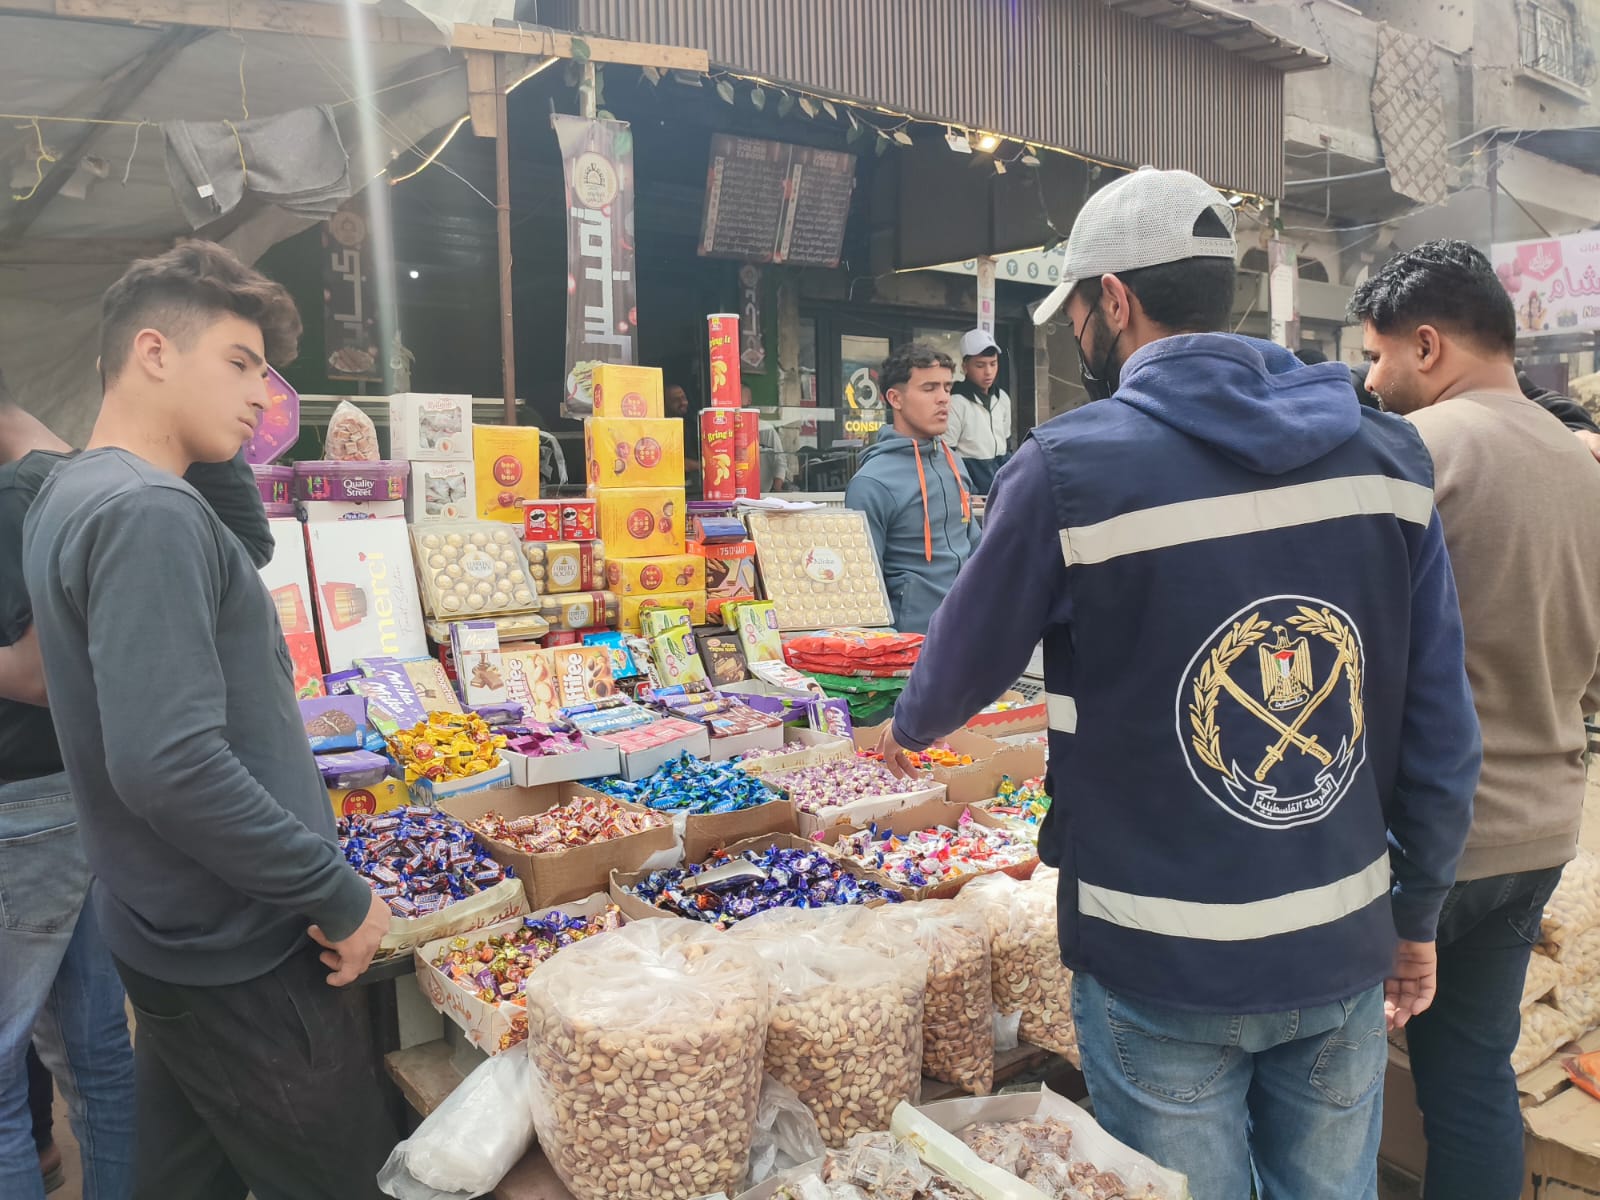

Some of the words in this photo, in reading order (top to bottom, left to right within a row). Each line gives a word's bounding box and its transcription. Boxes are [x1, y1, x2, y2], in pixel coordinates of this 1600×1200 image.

[709, 336, 723, 348] ring
[343, 479, 375, 489] Quality
[346, 488, 372, 497] Street
[368, 552, 399, 655] merci
[382, 669, 416, 706] Milka
[563, 653, 584, 704] ffifee
[368, 680, 405, 717] Milka
[829, 706, 850, 738] Mil
[1255, 795, 1303, 816] الفلسطينية
[1304, 781, 1334, 809] الشرطة
